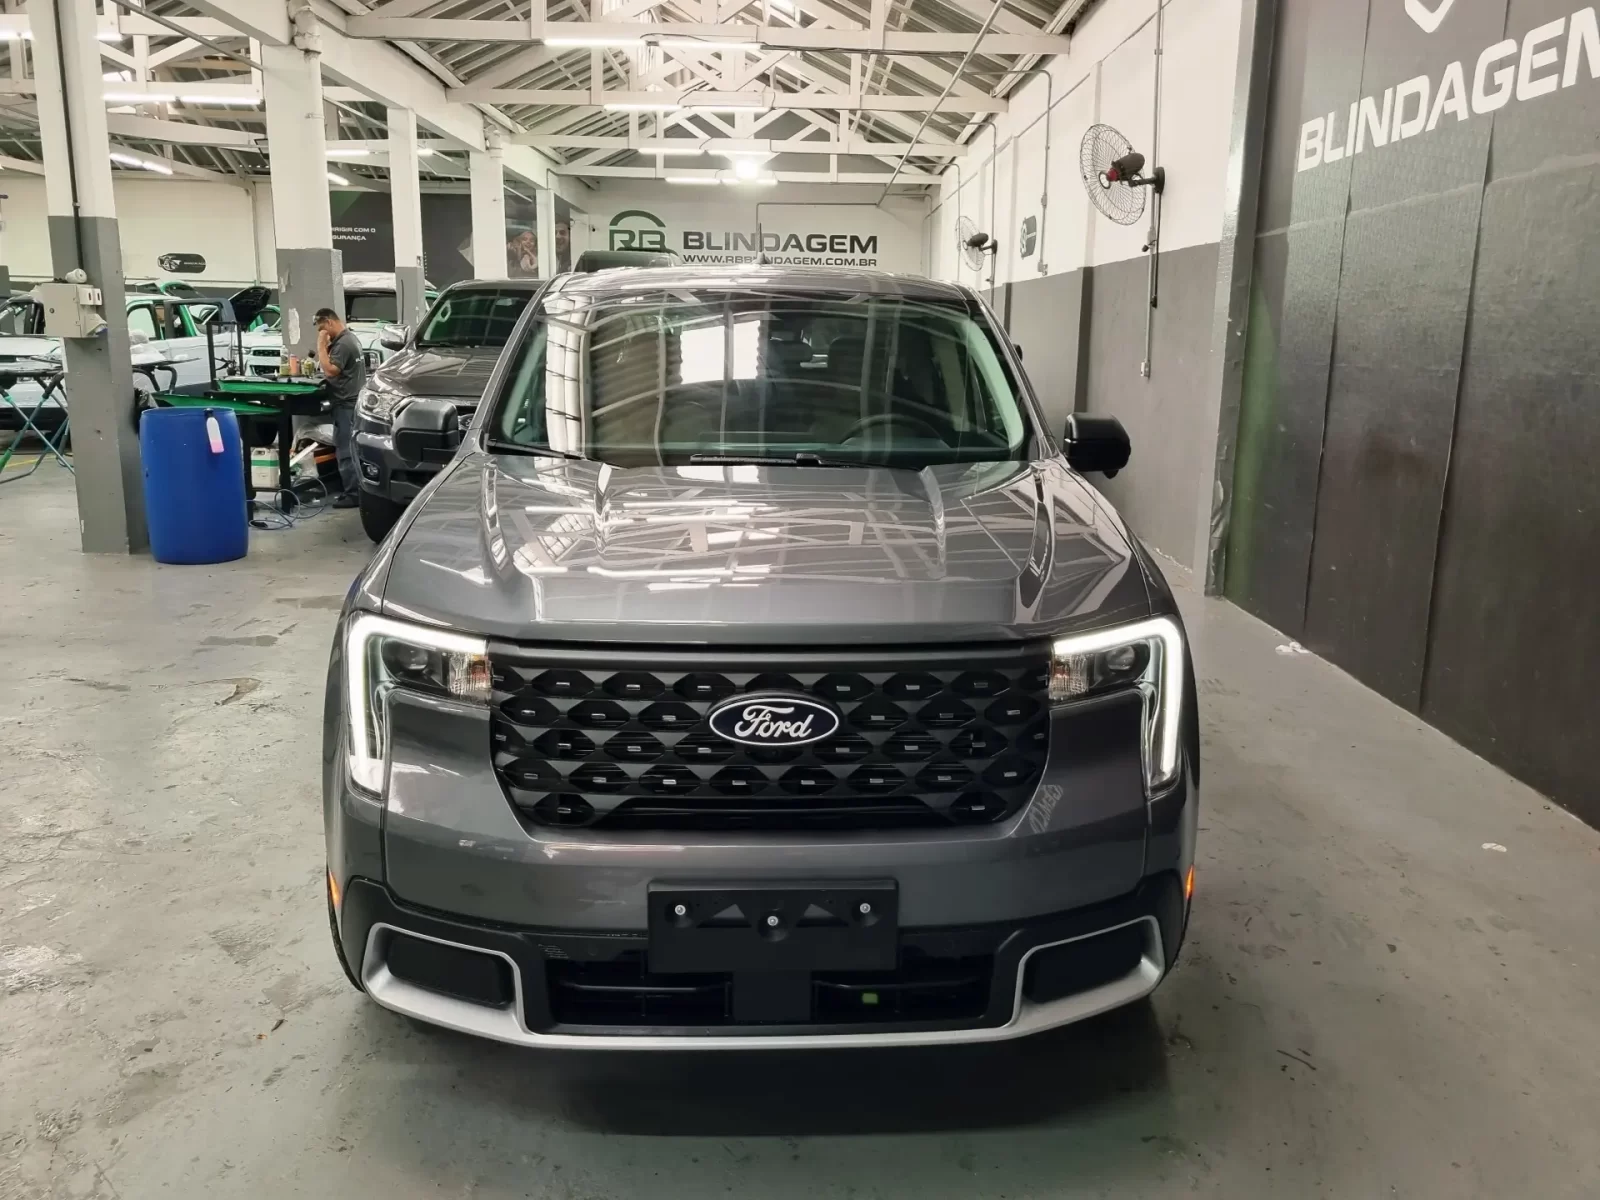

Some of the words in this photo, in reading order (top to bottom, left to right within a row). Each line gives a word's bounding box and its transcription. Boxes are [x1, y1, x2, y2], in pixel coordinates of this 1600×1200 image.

[683, 231, 878, 254] BLINDAGEM
[683, 254, 877, 267] WWW.RBBNDAGEM.COM.BR
[734, 704, 815, 738] Ford
